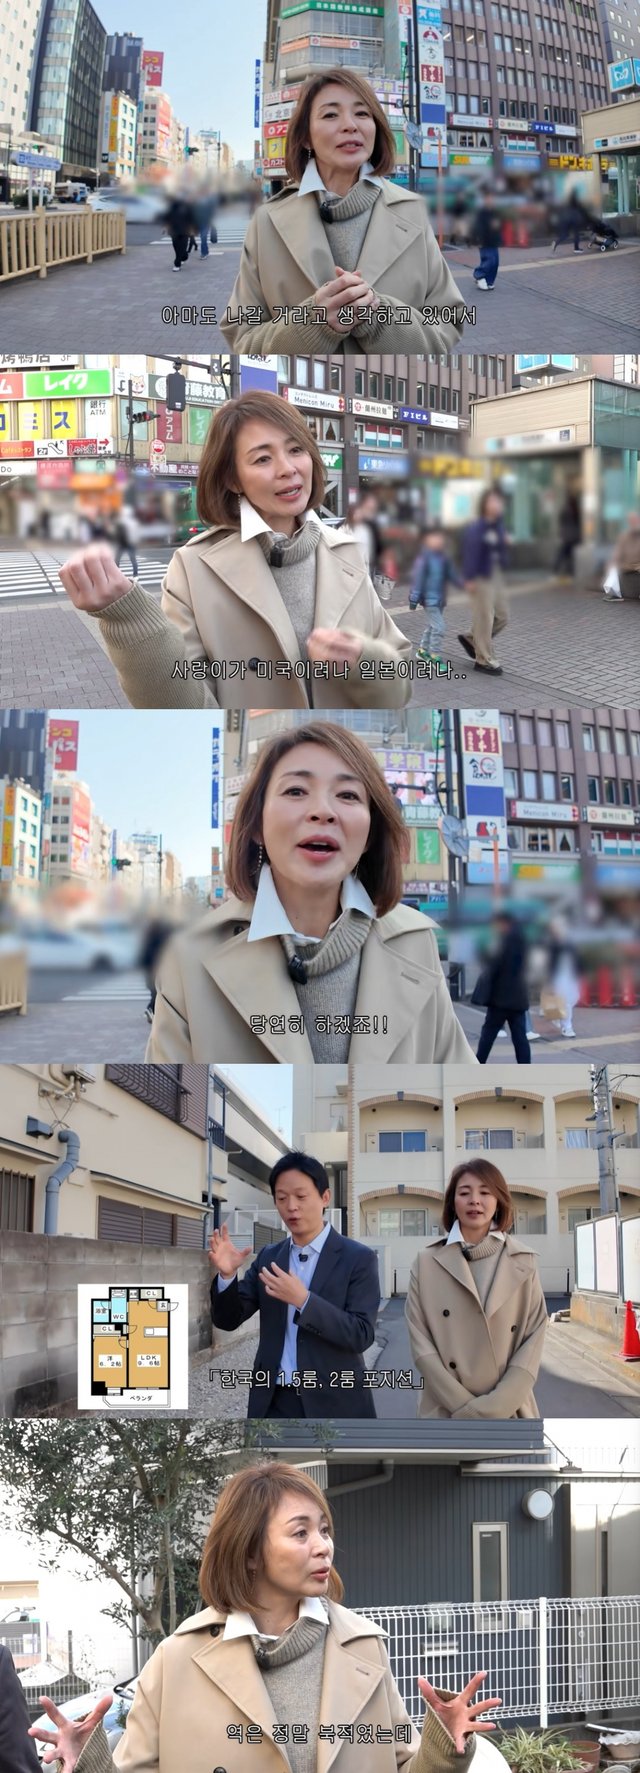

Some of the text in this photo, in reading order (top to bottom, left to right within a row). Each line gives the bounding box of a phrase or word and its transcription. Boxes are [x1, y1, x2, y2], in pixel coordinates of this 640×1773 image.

[44, 373, 88, 391] レイク
[90, 401, 106, 409] 銀行
[166, 416, 174, 441] アコム
